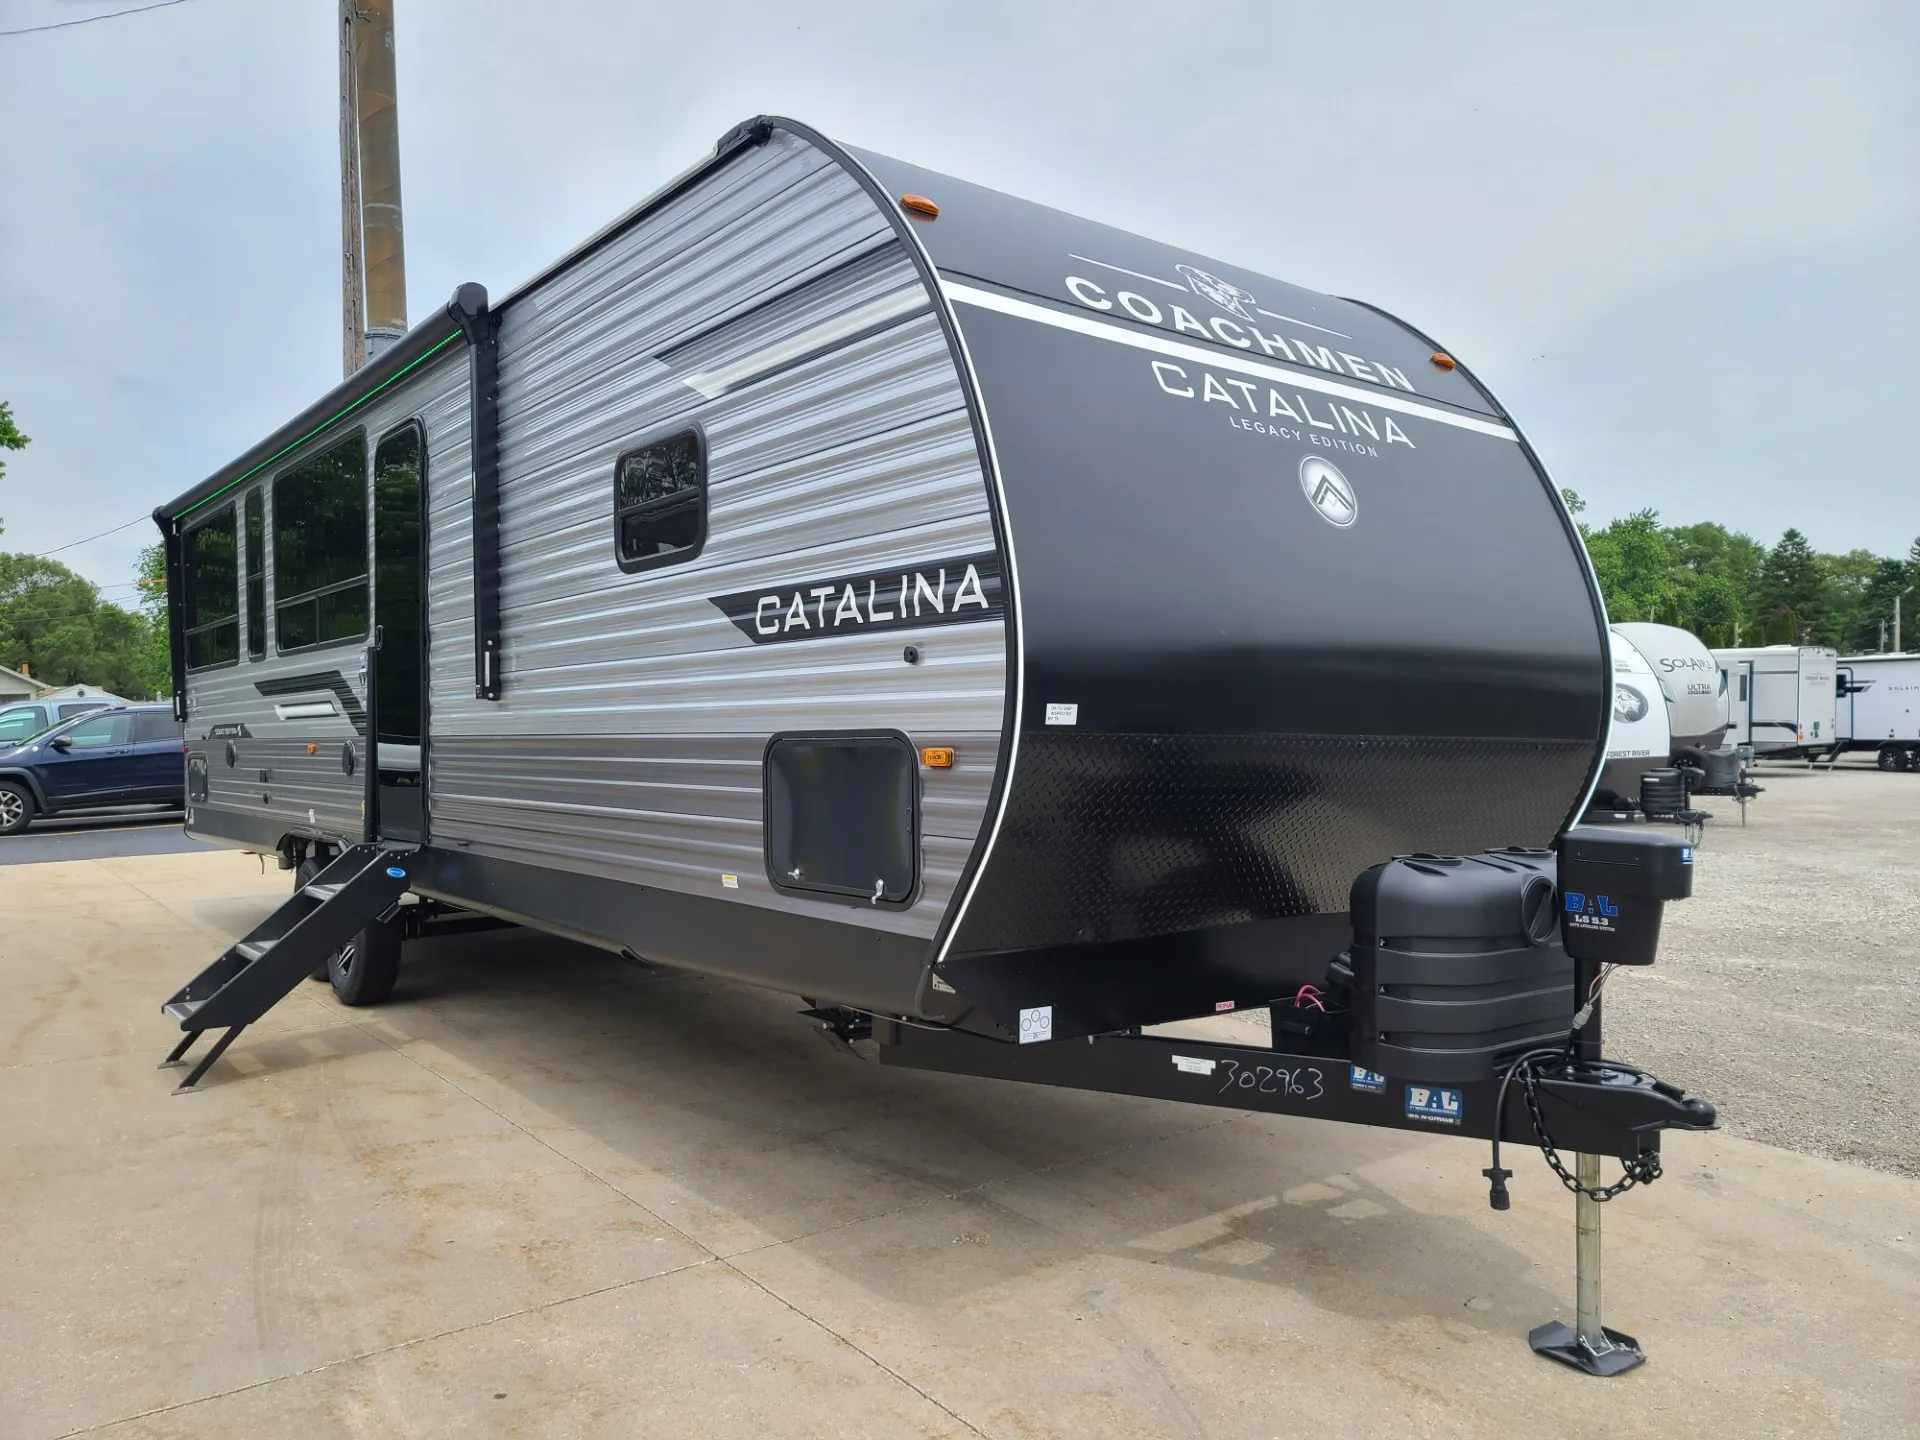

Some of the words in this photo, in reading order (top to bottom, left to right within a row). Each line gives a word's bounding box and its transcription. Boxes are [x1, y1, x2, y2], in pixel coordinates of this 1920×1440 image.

[1065, 276, 1416, 392] COACHMEN
[1151, 361, 1416, 448] CATALINA
[1229, 415, 1301, 442] LEGACY
[1310, 433, 1378, 458] EDITION
[755, 564, 989, 635] CATALINA
[1575, 914, 1589, 923] LS
[1218, 1060, 1324, 1100] 302963
